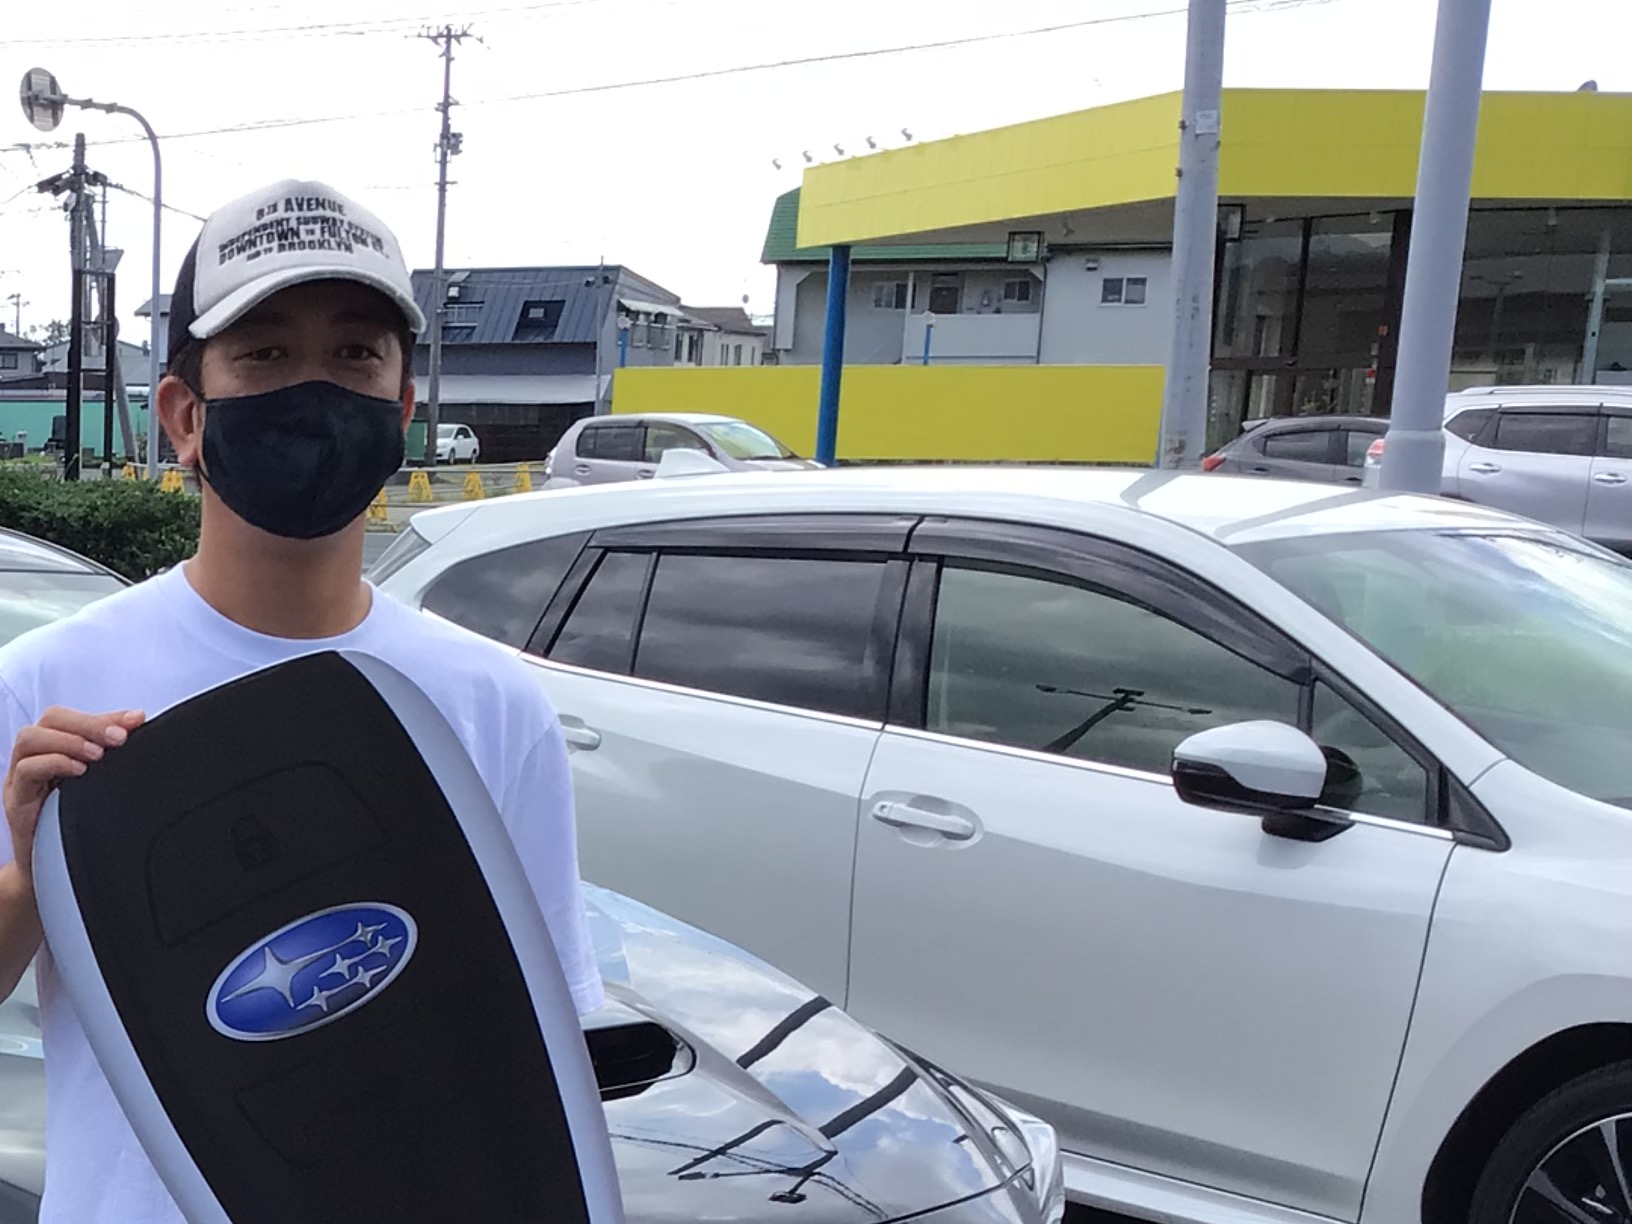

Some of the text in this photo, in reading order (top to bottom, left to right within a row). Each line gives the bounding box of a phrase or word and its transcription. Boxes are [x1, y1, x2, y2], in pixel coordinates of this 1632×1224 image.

[284, 196, 346, 216] AVENUE
[219, 217, 291, 253] INDEPENDENT
[296, 215, 345, 228] SUBWAY
[219, 226, 301, 266] DOWNTOWN
[304, 228, 316, 236] TO
[320, 225, 369, 249] FULTON
[277, 239, 354, 254] BROOKLYN
